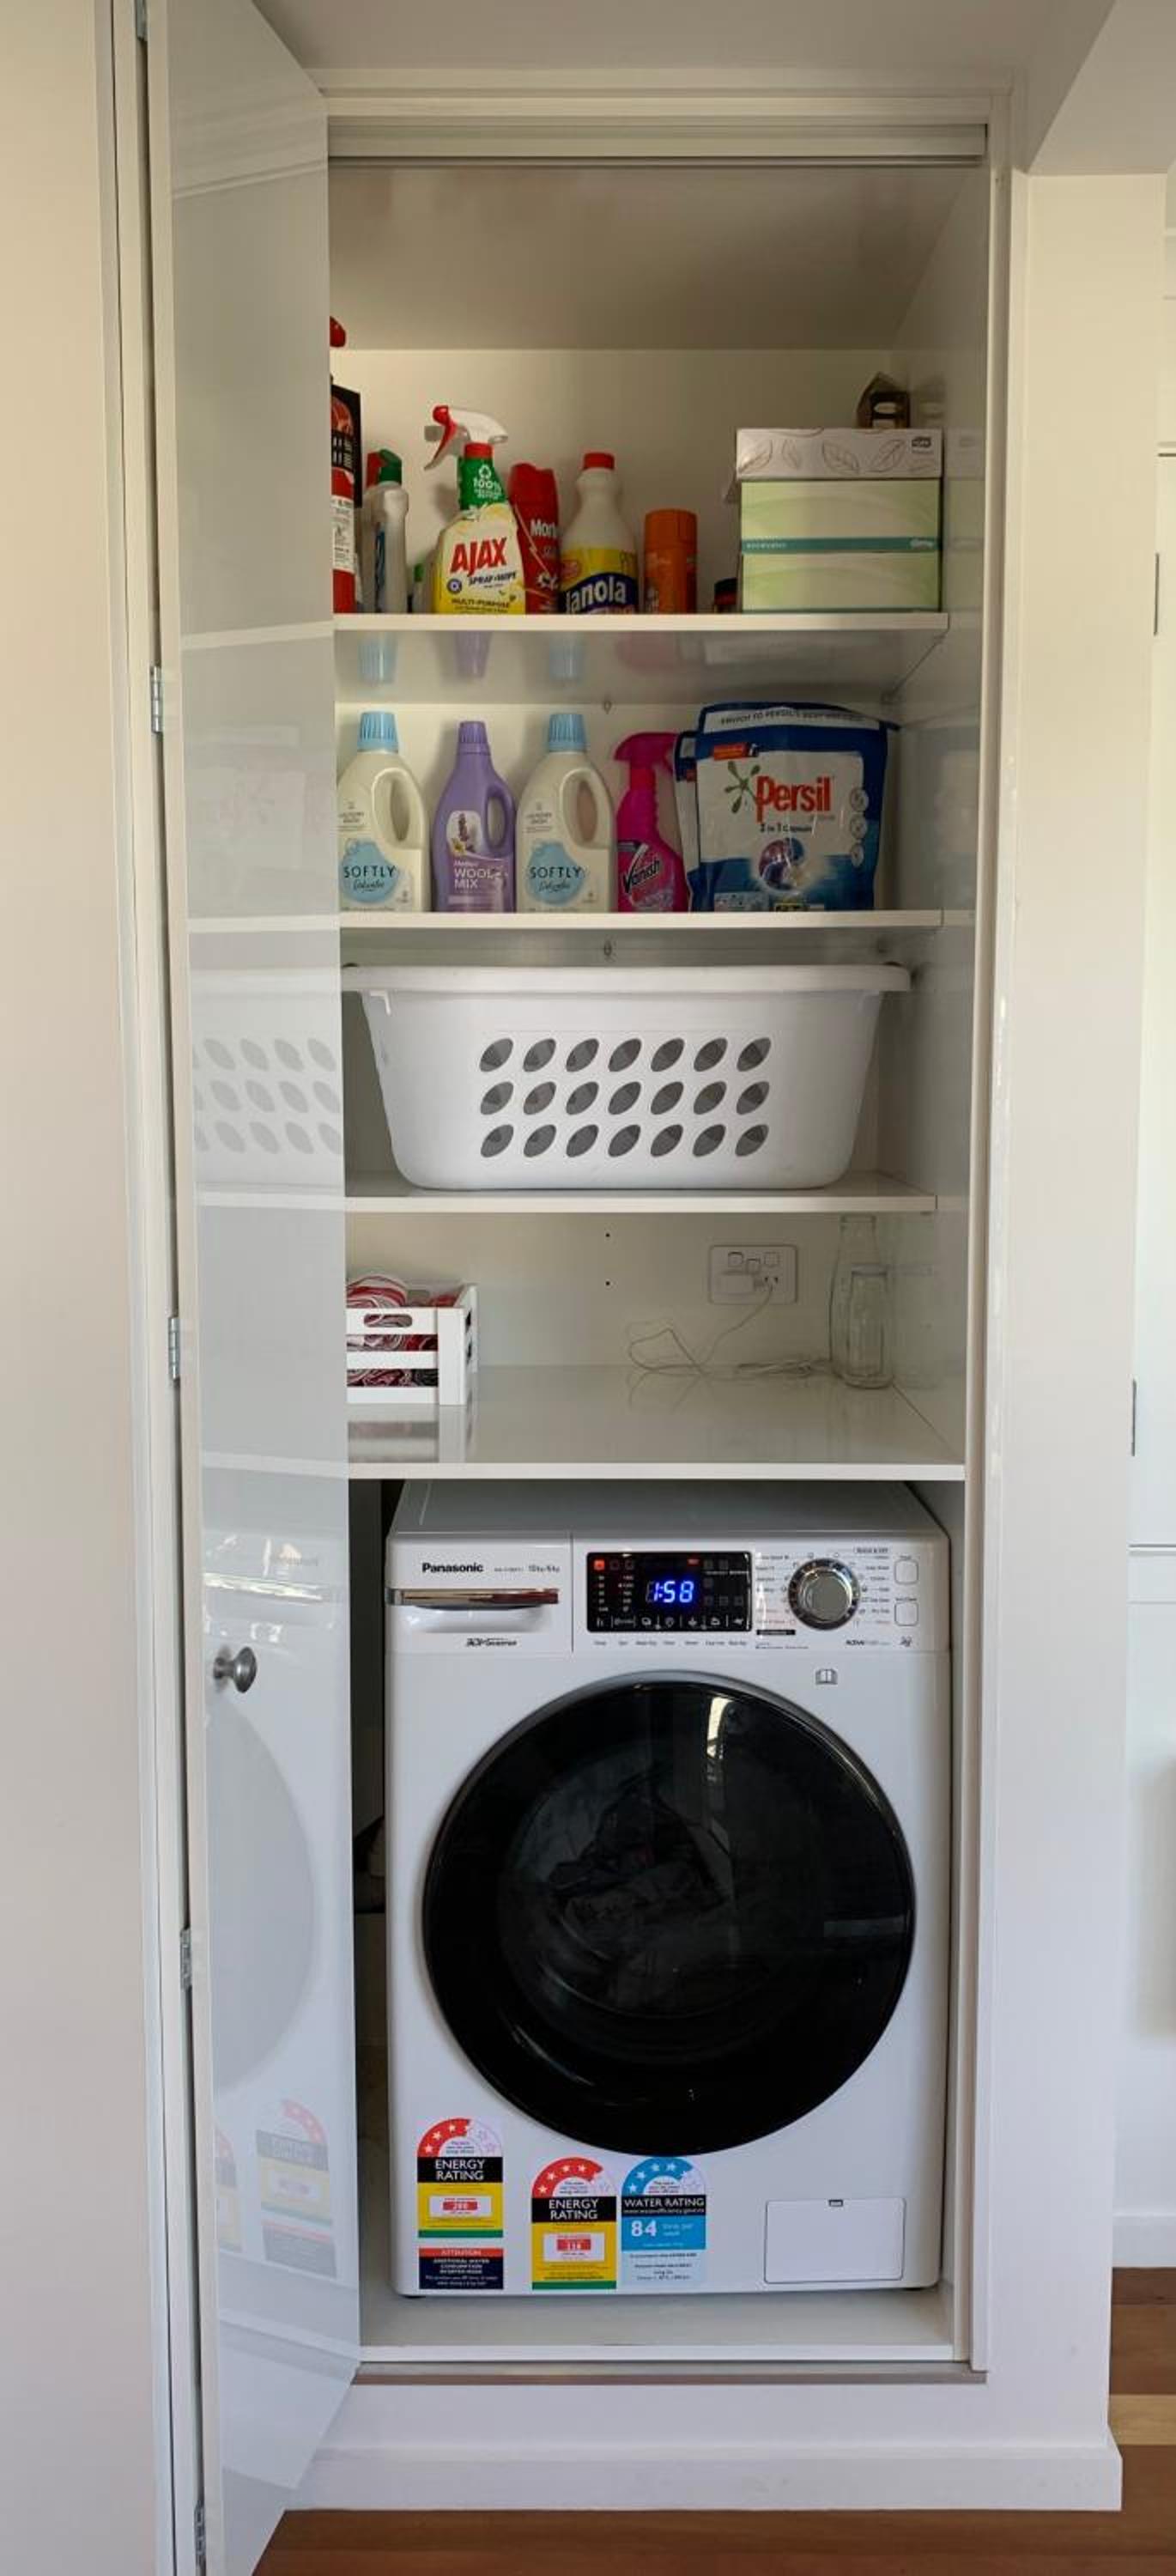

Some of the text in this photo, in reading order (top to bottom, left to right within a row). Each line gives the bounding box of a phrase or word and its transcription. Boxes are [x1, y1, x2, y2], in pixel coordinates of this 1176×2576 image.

[450, 538, 507, 576] AJAX
[756, 775, 831, 823] Persil
[343, 865, 397, 878] SOFTLY
[454, 868, 494, 878] WOOL
[529, 866, 582, 878] SOFTLY
[454, 879, 478, 890] MIX
[421, 1562, 484, 1573] Panasonic
[653, 1580, 694, 1604] 1:58
[434, 2159, 486, 2170] ENERGY
[436, 2170, 484, 2181] RATING
[549, 2199, 599, 2209] ENERGY
[623, 2197, 705, 2208] WATER RATING
[550, 2210, 598, 2221] RATING
[631, 2220, 658, 2238] 84
